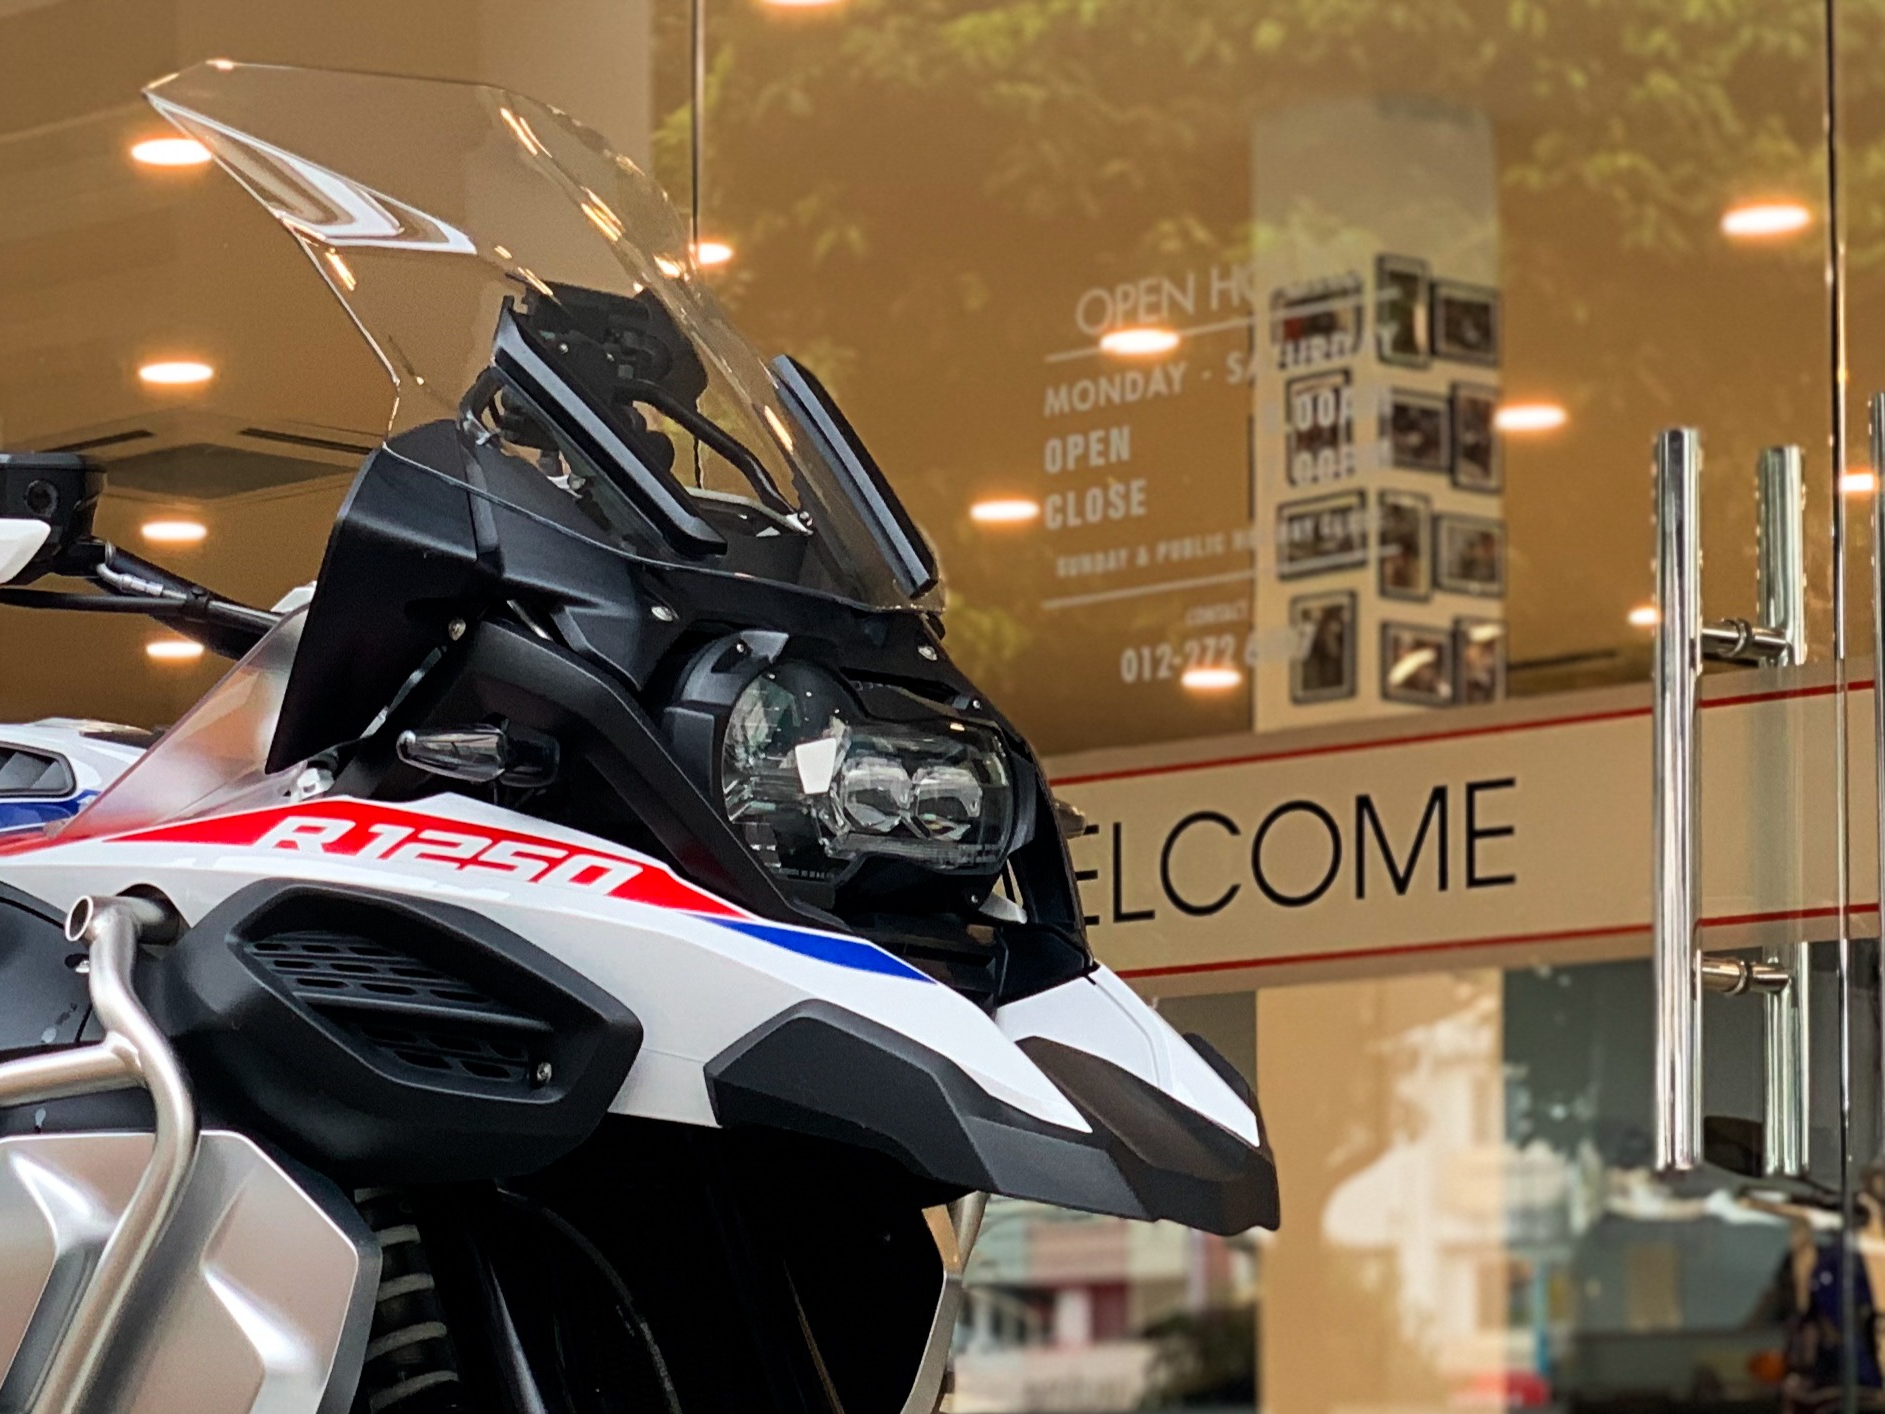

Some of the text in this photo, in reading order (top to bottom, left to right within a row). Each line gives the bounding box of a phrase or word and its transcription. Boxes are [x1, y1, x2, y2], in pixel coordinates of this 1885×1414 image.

[1074, 272, 1196, 336] OPEN
[1043, 361, 1188, 417] MONDAY
[1043, 426, 1131, 474] OPEN
[1044, 480, 1147, 531] CLOSE
[1055, 546, 1130, 579] SUNDAY
[1156, 532, 1227, 563] PUBLIC
